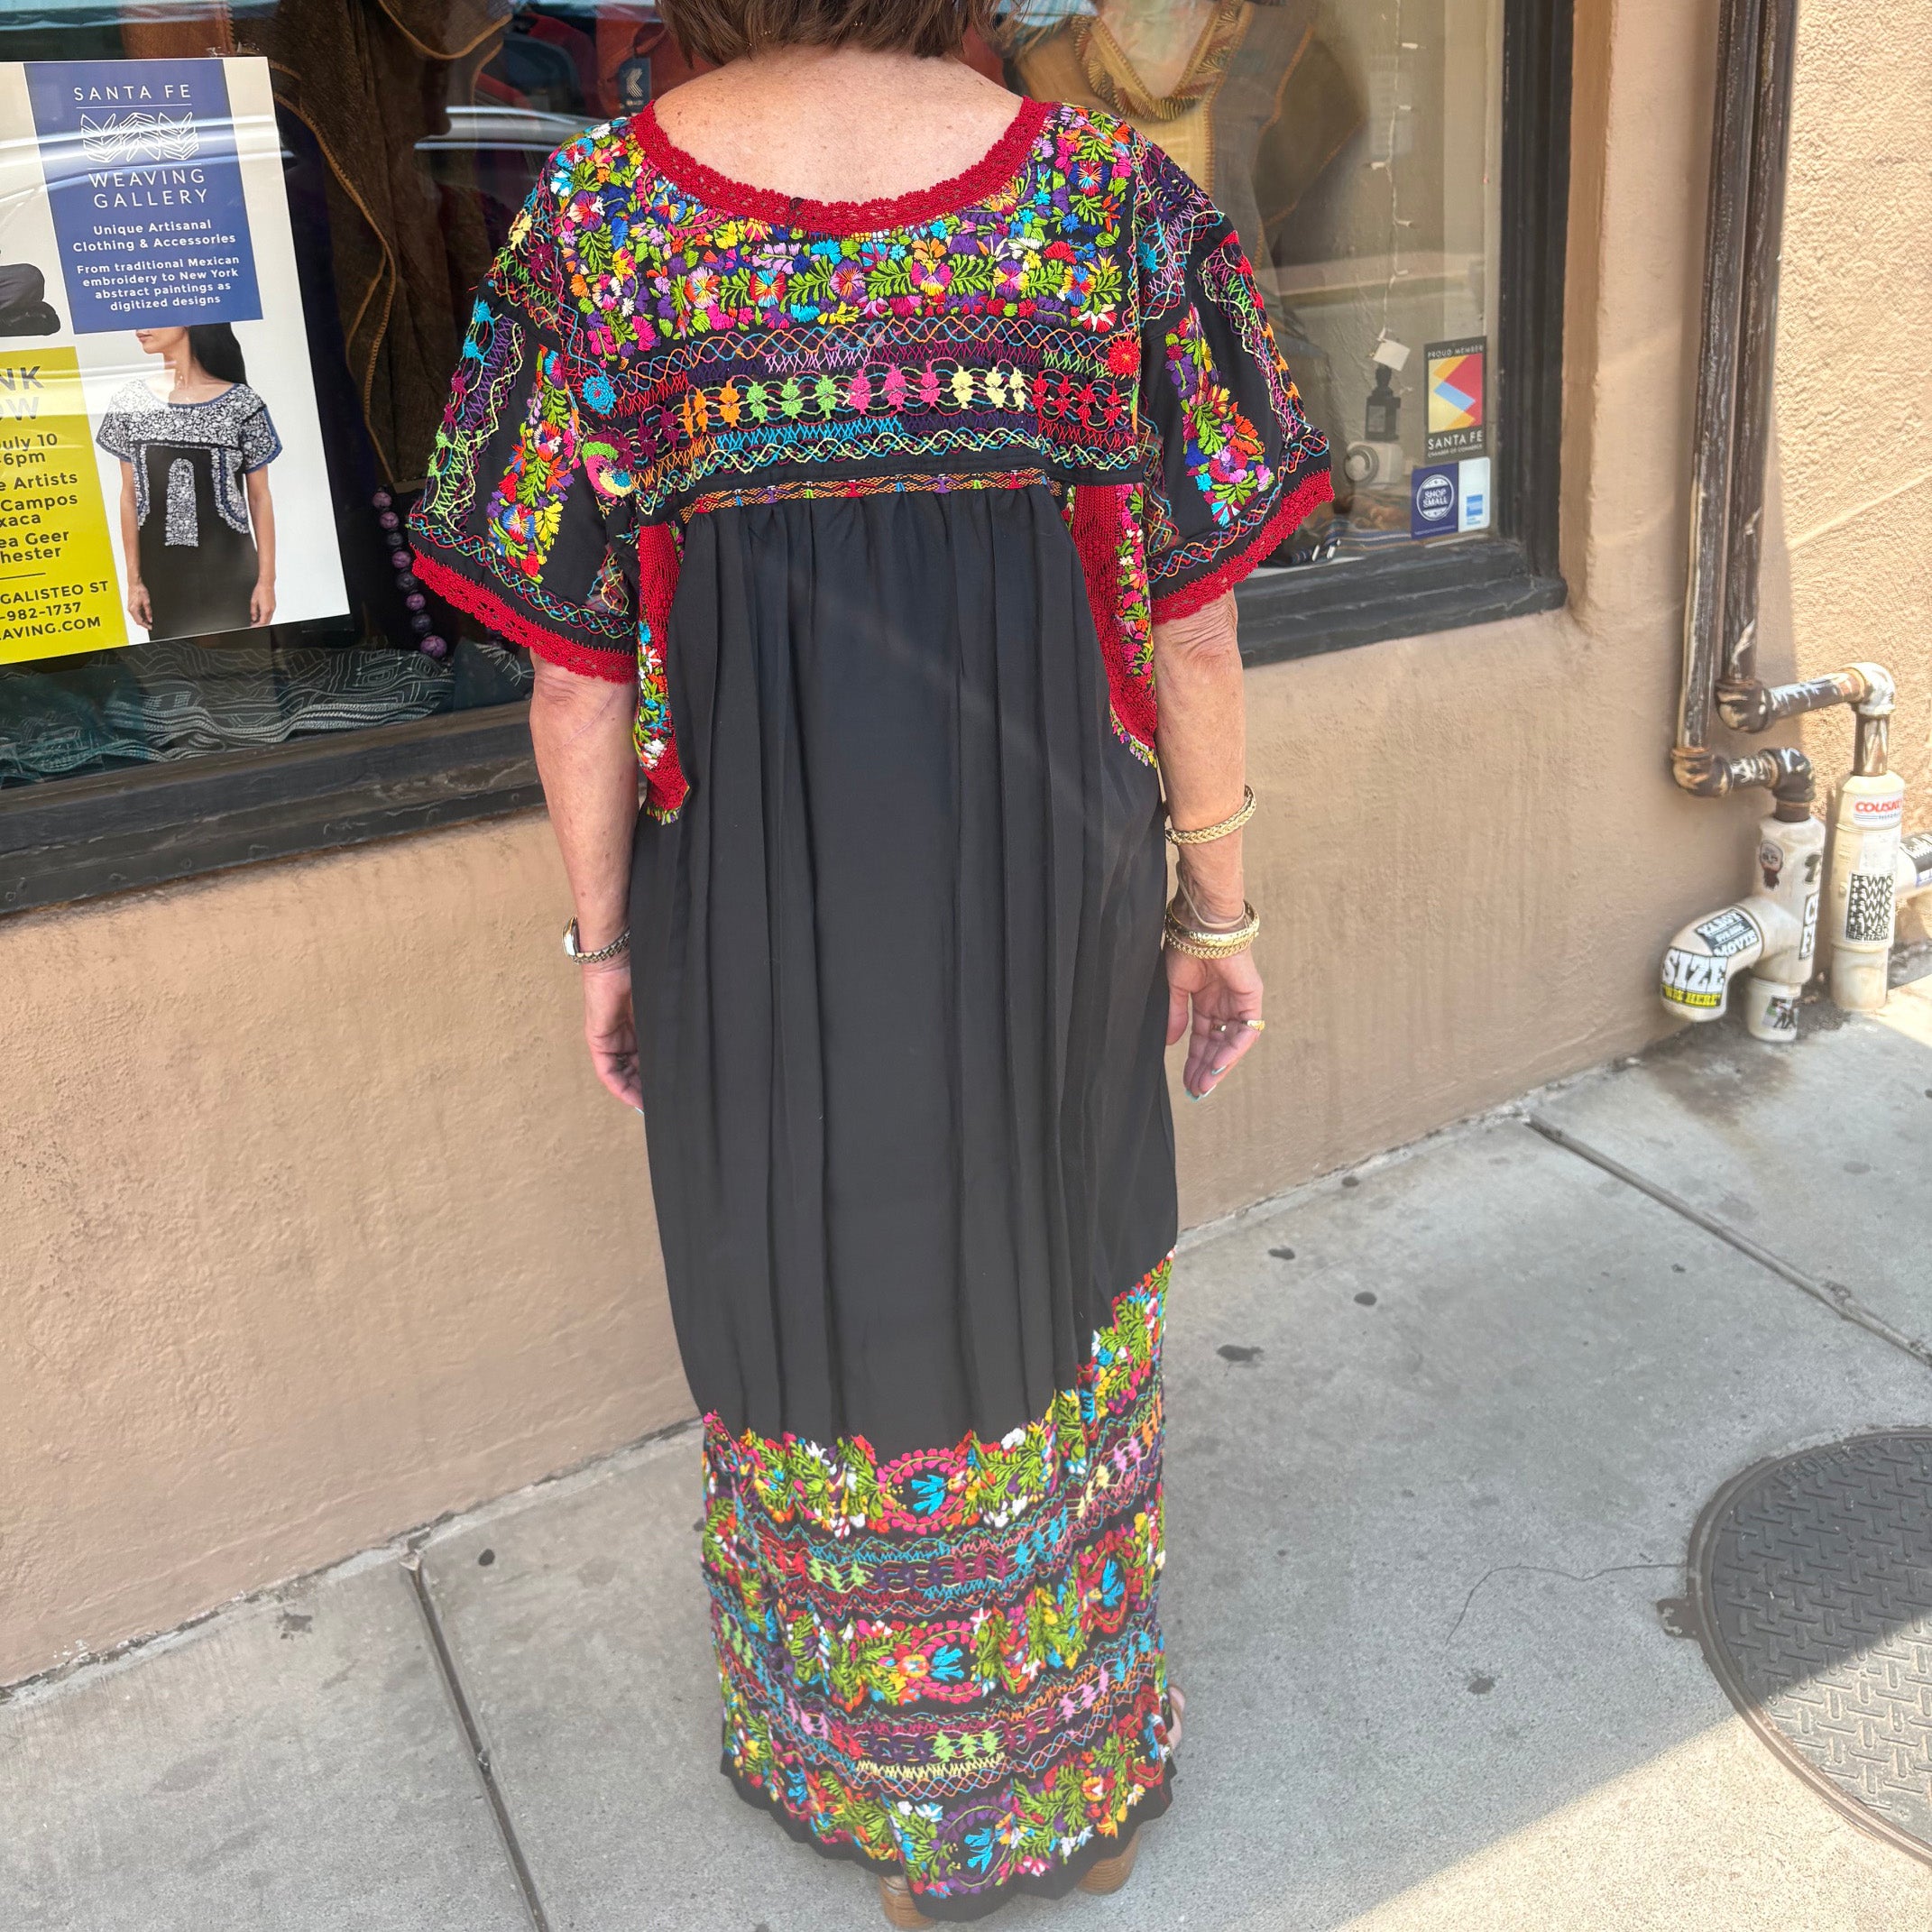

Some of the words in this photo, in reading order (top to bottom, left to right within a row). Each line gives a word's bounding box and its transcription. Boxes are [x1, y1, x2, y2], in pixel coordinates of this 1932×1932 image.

[74, 86, 152, 101] SANTA
[165, 84, 191, 98] FE
[88, 169, 205, 189] WEAVING
[94, 189, 208, 208] GALLERY
[93, 223, 143, 237] Unique
[148, 219, 212, 233] Artisanal
[72, 238, 134, 253] Clothing
[139, 238, 149, 249] &
[153, 234, 236, 247] Accessories
[77, 263, 110, 275] From
[115, 259, 184, 272] traditional
[188, 255, 240, 268] Mexican
[82, 272, 157, 288] embroidery
[161, 271, 176, 282] to
[179, 270, 207, 281] New
[210, 267, 239, 280] York
[95, 287, 149, 300] abstract
[153, 282, 214, 299] paintings
[217, 281, 231, 292] as
[110, 297, 169, 312] digitized
[172, 294, 221, 308] designs
[1427, 349, 1452, 358] PROUD
[1455, 345, 1484, 354] MEMBER
[0, 397, 39, 420] W
[0, 436, 31, 451] uly
[37, 433, 58, 446] 10
[1428, 434, 1467, 450] SANTA
[1470, 430, 1483, 443] FE
[14, 473, 78, 490] Artists
[0, 494, 78, 511] Campos
[1422, 496, 1449, 509] SMALL
[1424, 488, 1447, 499] SHOP
[25, 531, 69, 545] Geer
[0, 547, 61, 564] hester
[0, 584, 84, 604] GALISTEO
[89, 581, 108, 593] ST
[0, 616, 101, 640] AVING.COM
[1662, 948, 1728, 994] SIZE
